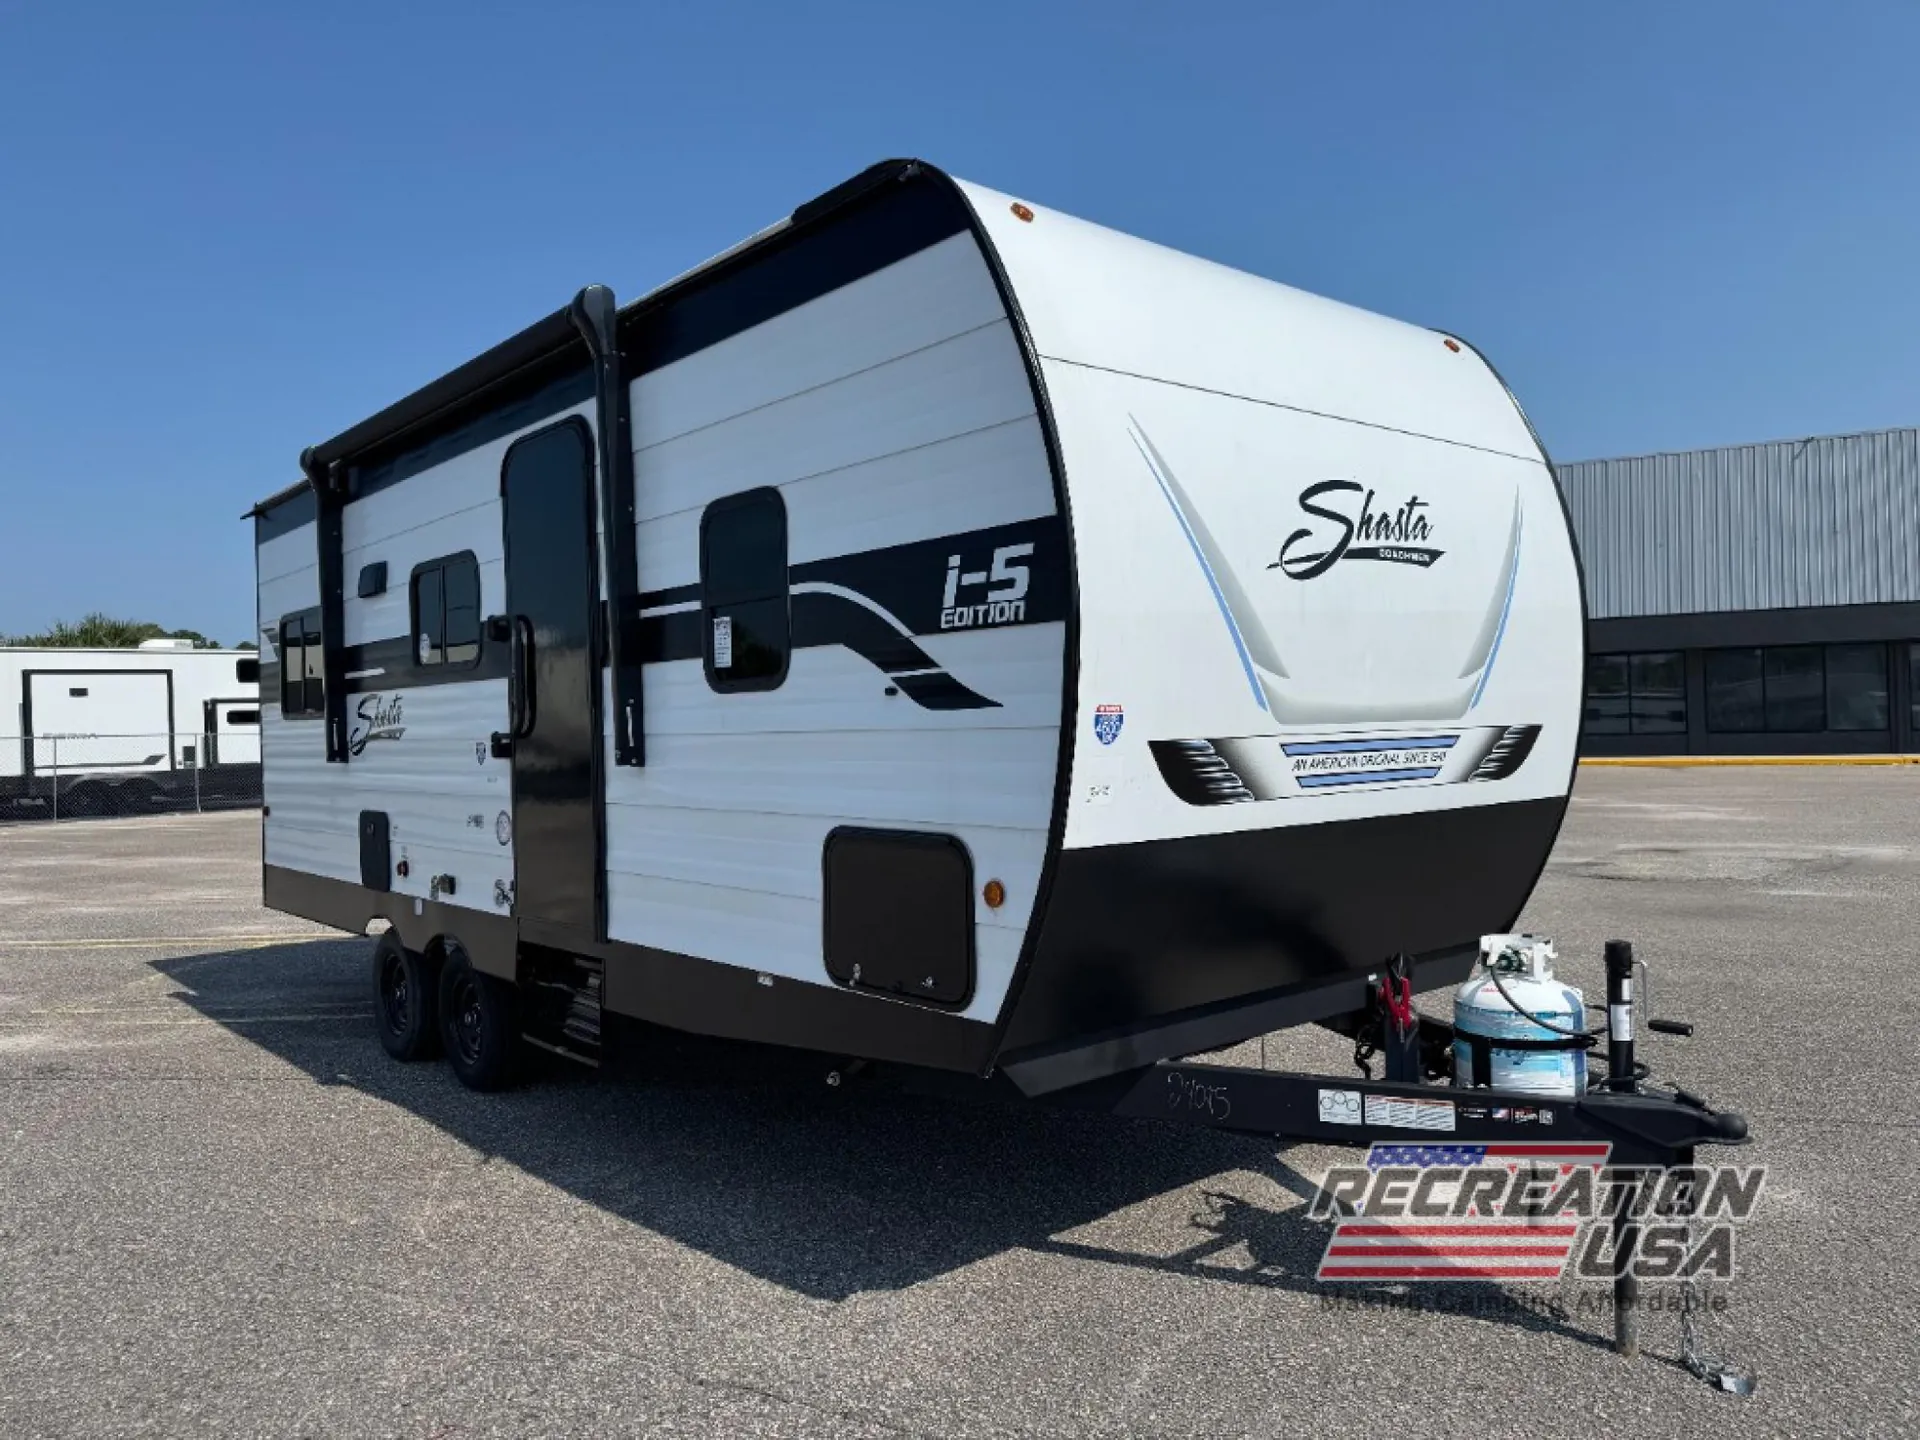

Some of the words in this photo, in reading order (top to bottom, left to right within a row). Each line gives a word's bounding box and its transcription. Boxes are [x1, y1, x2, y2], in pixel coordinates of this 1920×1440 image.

[1279, 480, 1434, 581] Shasta
[1379, 549, 1430, 562] COACHMEN
[943, 543, 1034, 608] i-5
[941, 601, 1025, 628] EDITION
[1291, 757, 1308, 773] AN
[1310, 756, 1358, 770] AMERICAN
[1361, 754, 1400, 767] ORIGINAL
[1402, 752, 1428, 764] SINCE
